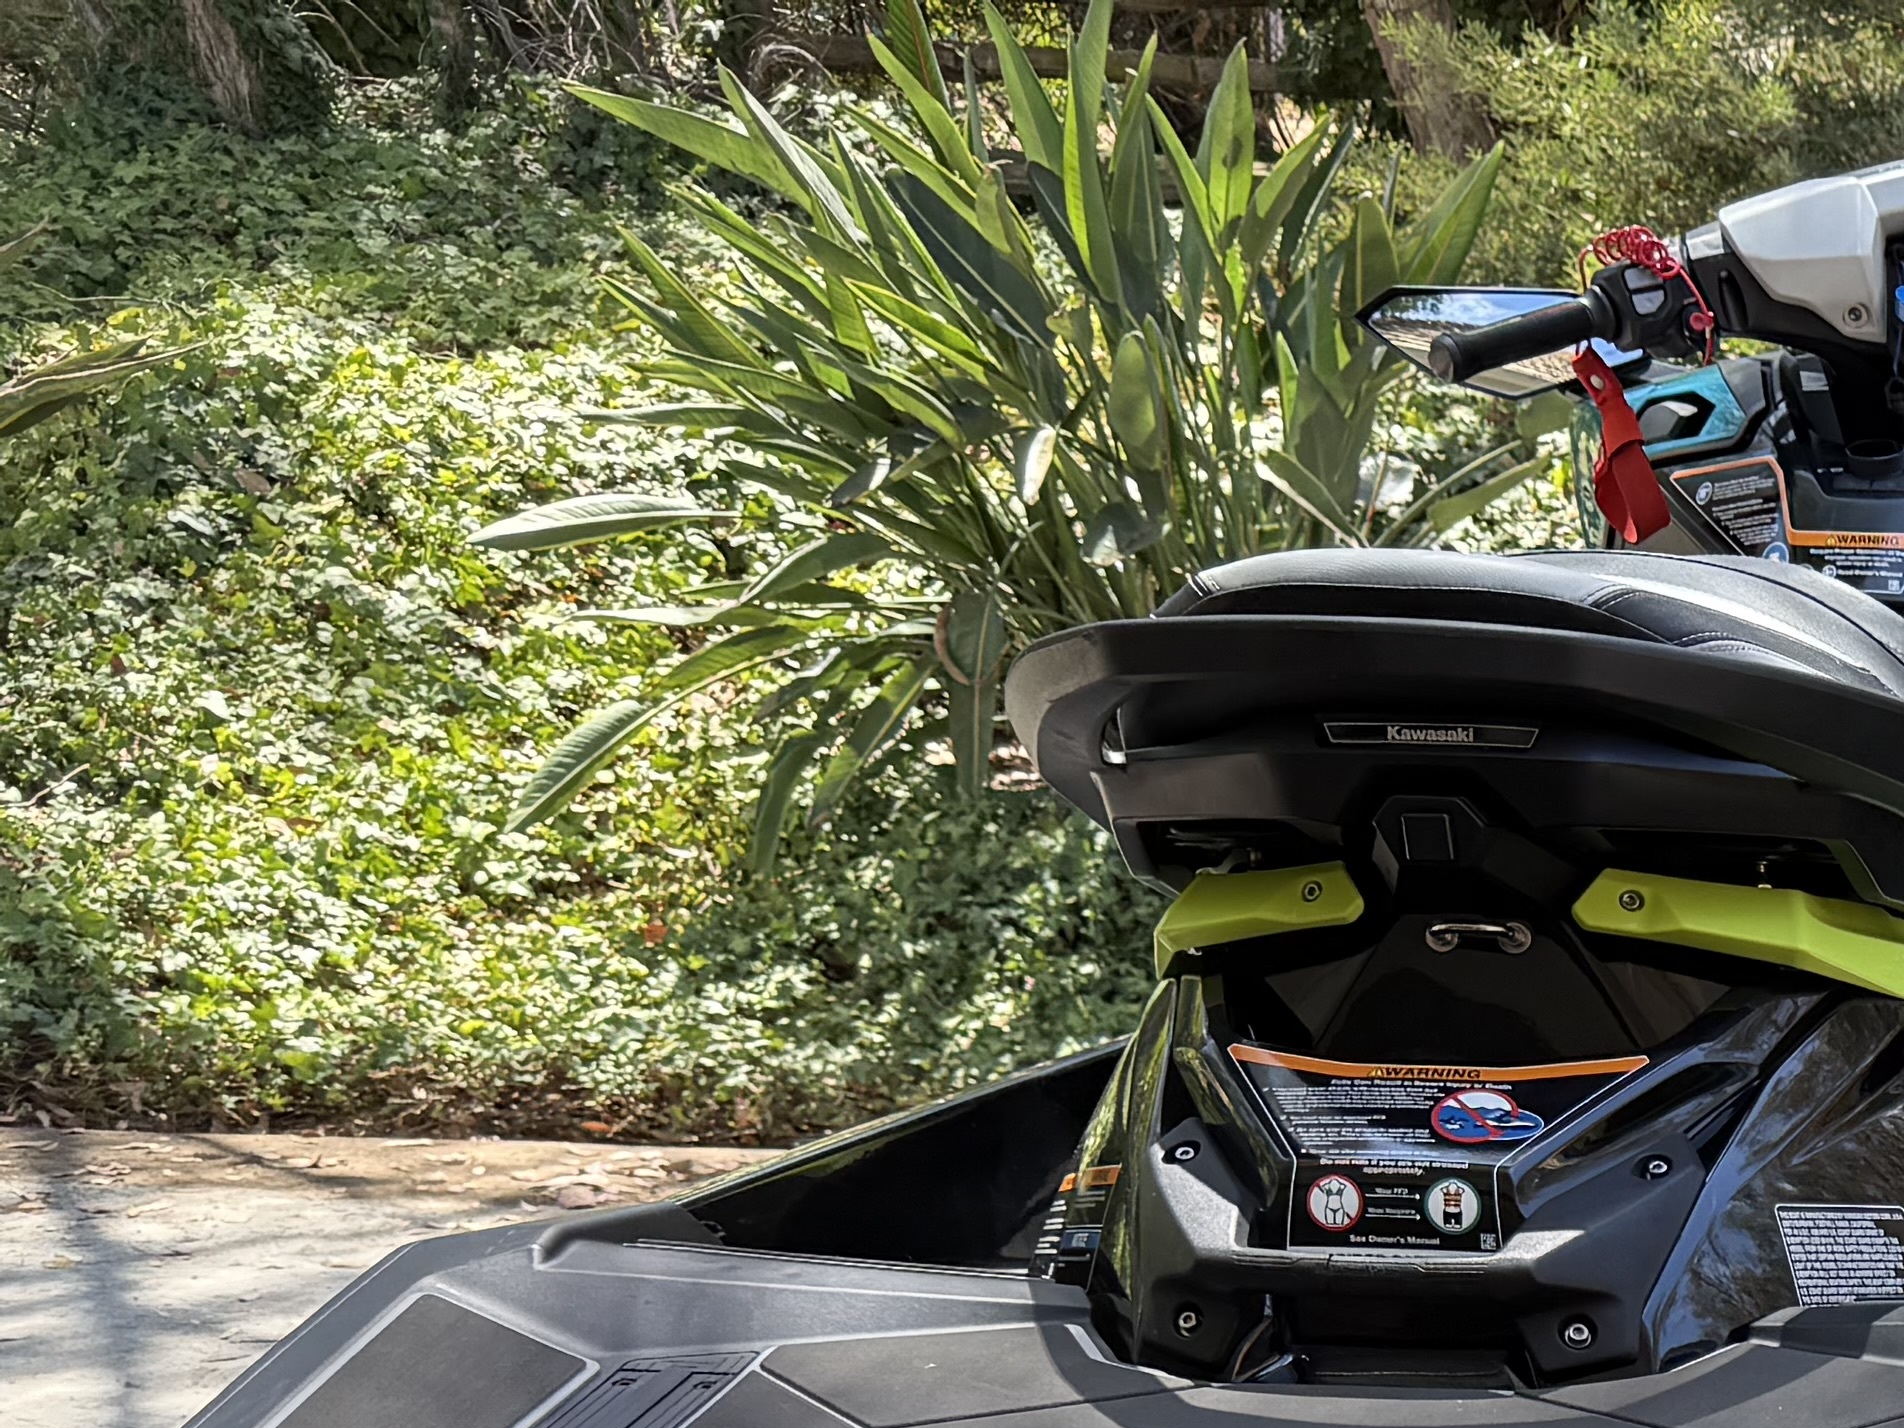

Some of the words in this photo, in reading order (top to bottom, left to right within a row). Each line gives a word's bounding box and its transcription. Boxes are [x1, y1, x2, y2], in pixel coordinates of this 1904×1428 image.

[1837, 535, 1899, 546] WARNING
[1387, 726, 1474, 742] Kawasaki
[1384, 1067, 1481, 1079] WARNING
